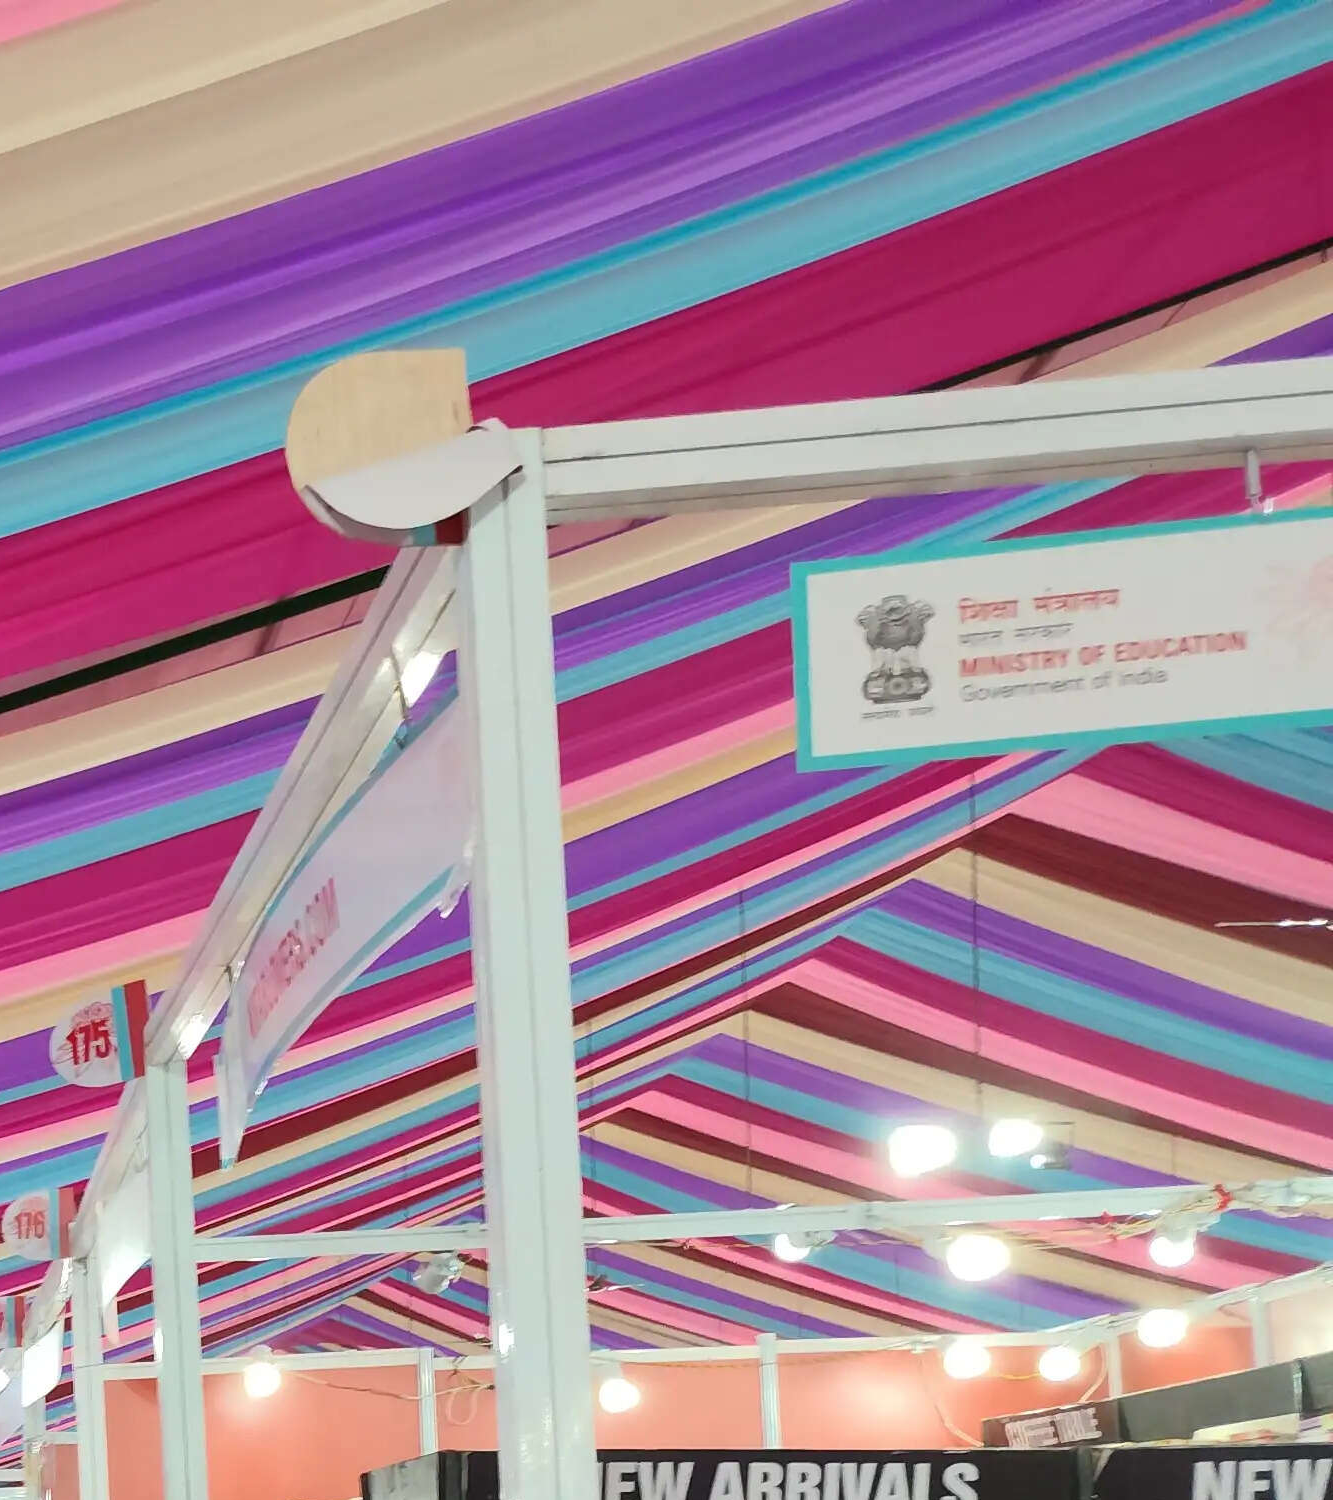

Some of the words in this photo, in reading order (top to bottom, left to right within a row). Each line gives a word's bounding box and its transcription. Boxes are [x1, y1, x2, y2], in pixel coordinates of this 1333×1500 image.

[958, 649, 1069, 678] MINISTRY
[1078, 644, 1104, 667] OF
[1114, 631, 1247, 663] EDUCATION
[959, 676, 1085, 703] Government
[1091, 672, 1116, 690] of
[65, 1018, 112, 1066] 175
[16, 1211, 45, 1239] 176
